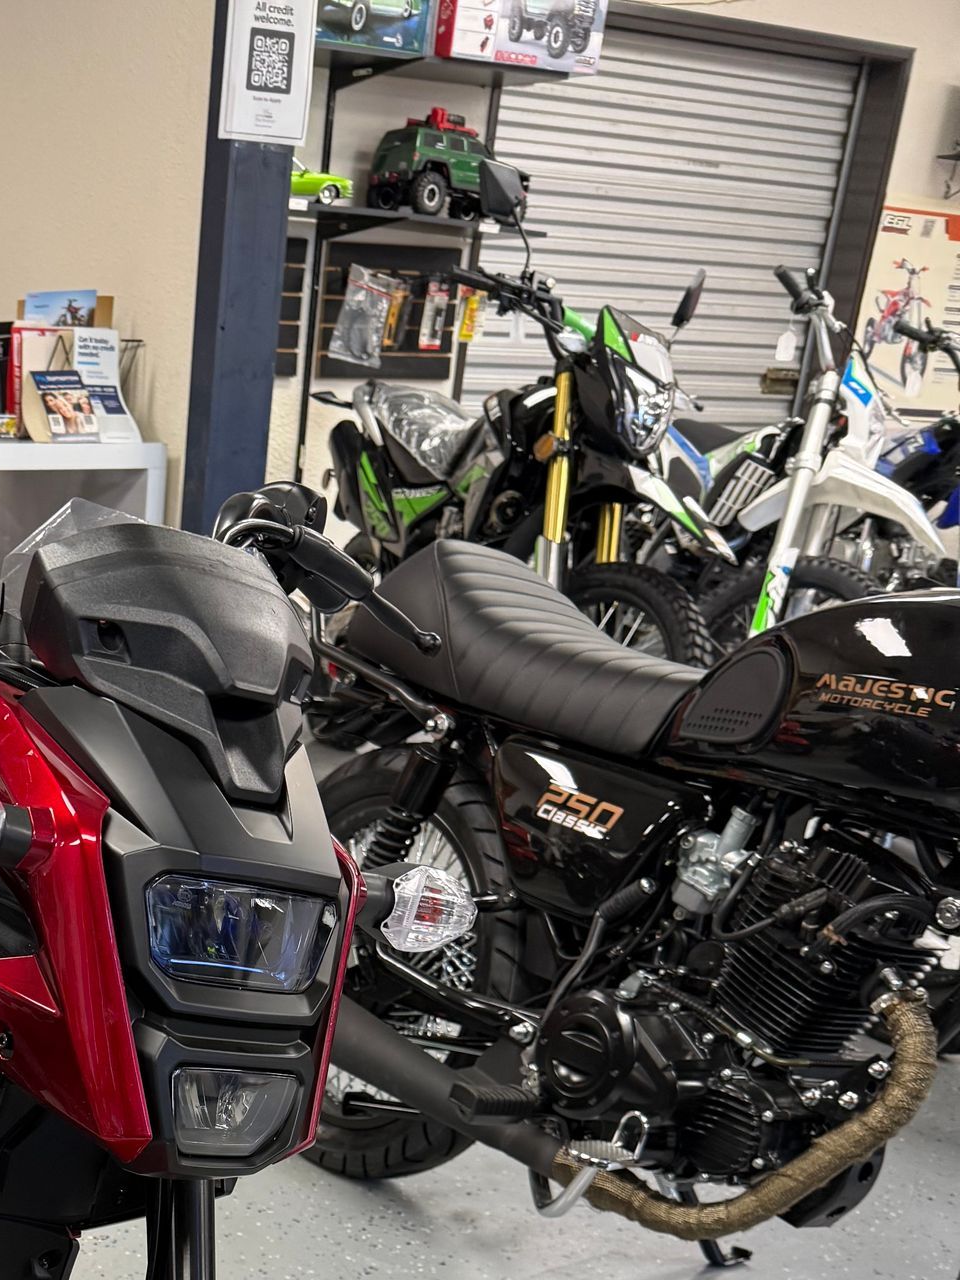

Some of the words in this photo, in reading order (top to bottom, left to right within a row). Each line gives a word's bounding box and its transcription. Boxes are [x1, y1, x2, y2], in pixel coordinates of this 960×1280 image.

[255, 1, 267, 12] All
[268, 4, 294, 16] credit
[254, 14, 294, 27] welcome.
[818, 692, 932, 718] MOTORCYCLE
[536, 784, 624, 832] 250
